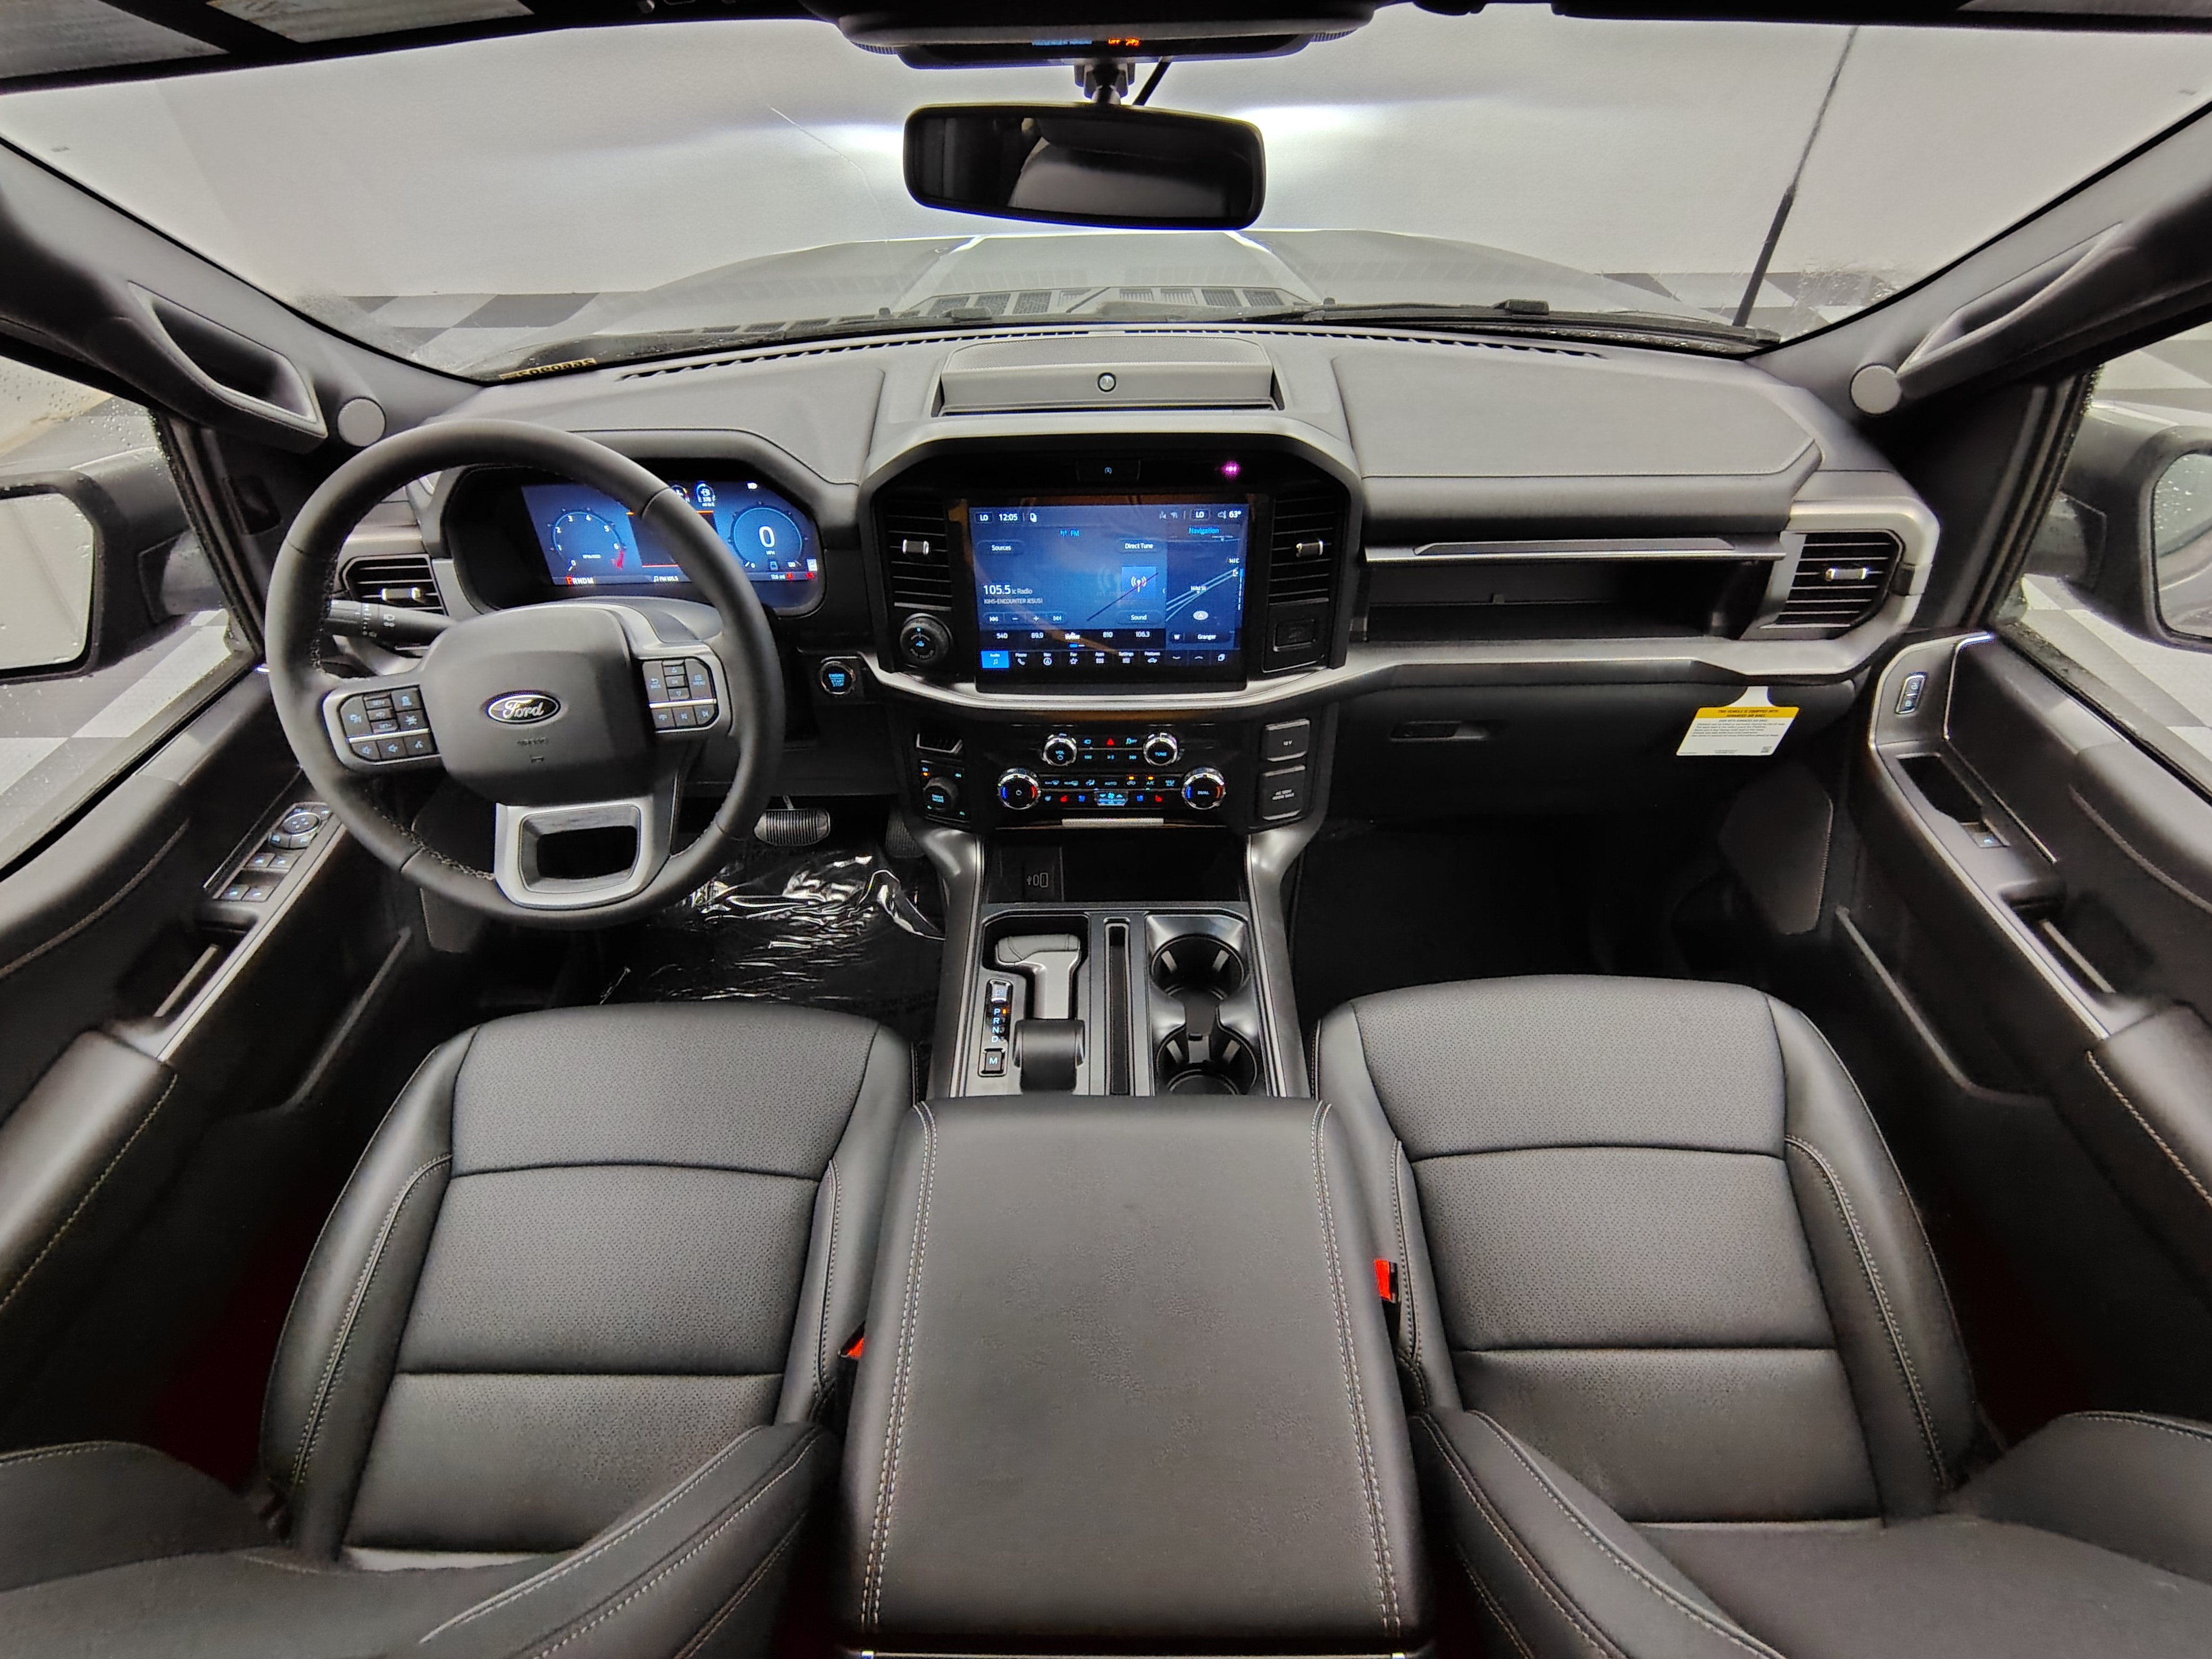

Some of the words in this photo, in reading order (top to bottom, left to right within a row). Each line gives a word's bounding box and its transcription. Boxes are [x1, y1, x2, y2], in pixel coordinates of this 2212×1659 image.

[759, 526, 775, 548] 0
[983, 584, 1011, 595] 105.5
[503, 698, 544, 719] Ford
